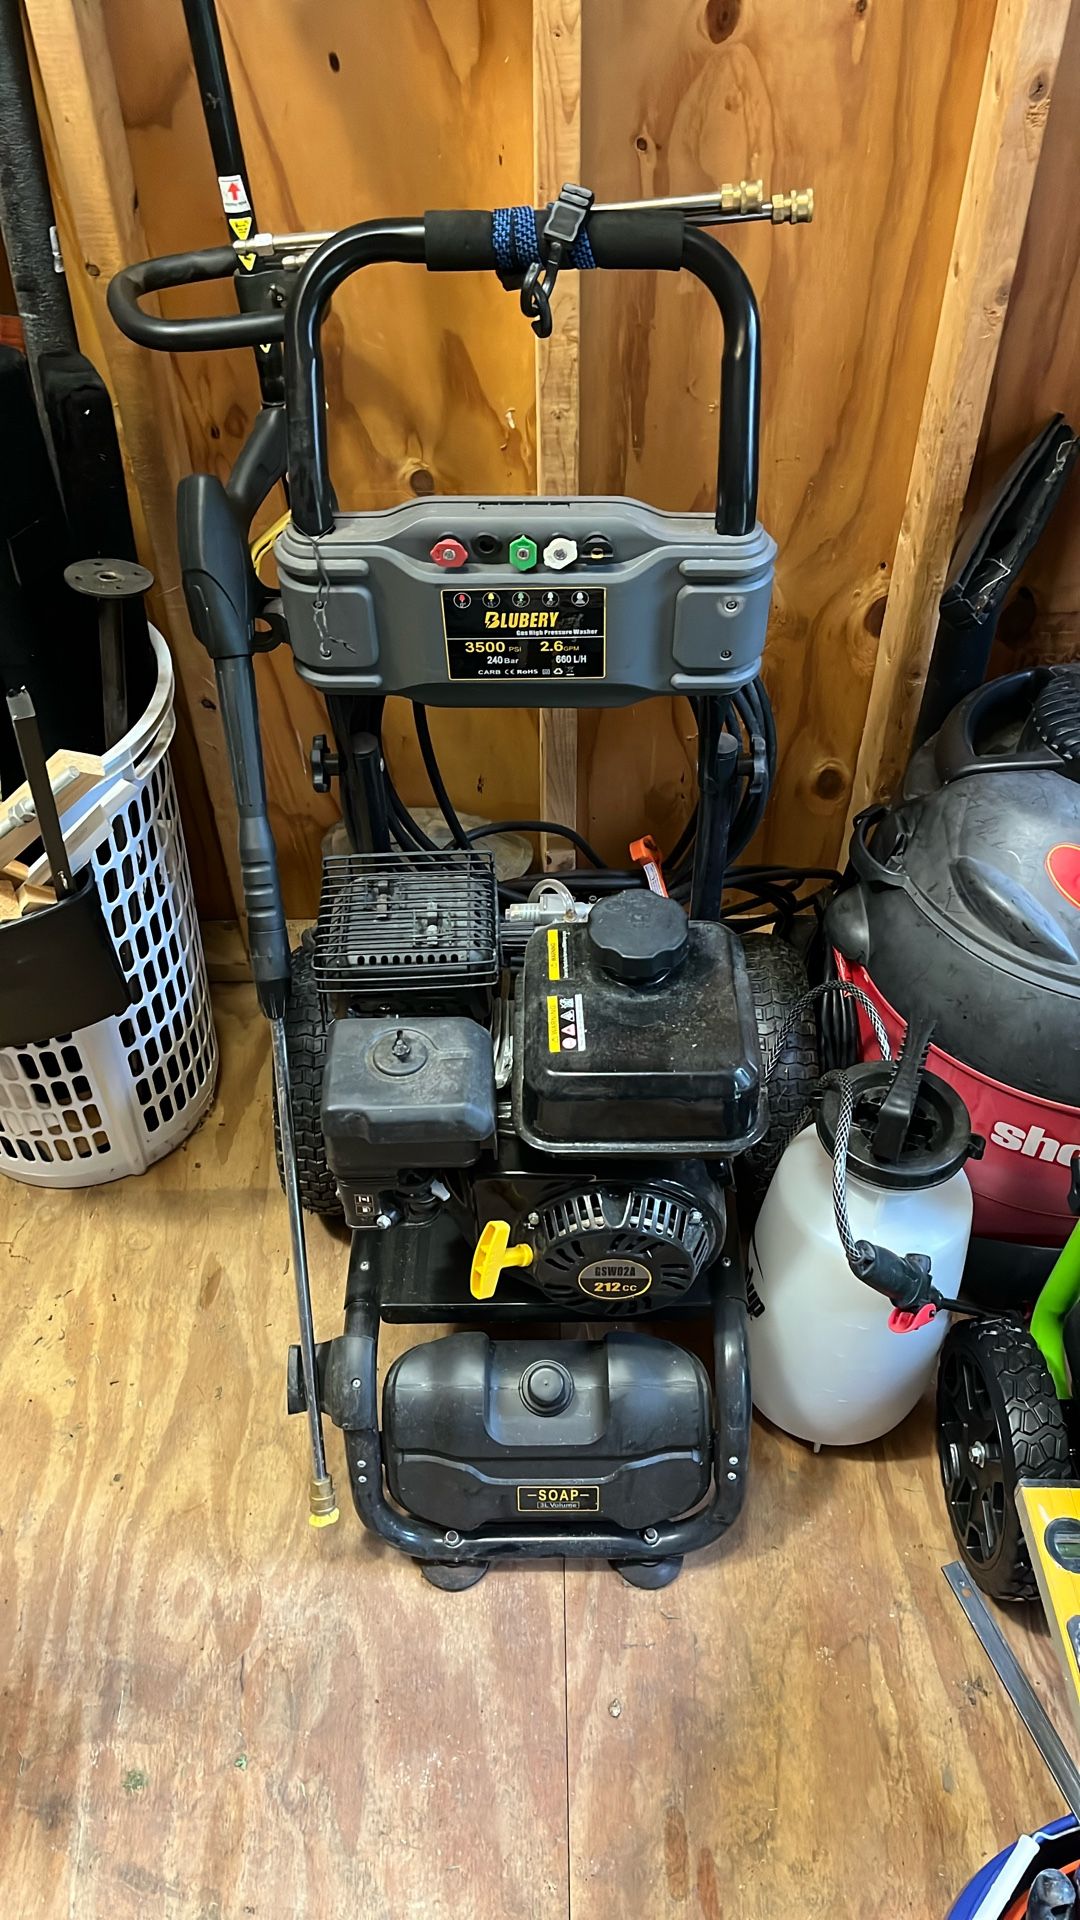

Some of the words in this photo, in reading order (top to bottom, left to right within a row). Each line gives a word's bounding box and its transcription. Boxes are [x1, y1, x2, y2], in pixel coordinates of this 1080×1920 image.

[484, 611, 560, 629] BLUBERY
[465, 641, 505, 653] 3500
[540, 641, 563, 652] 2.6
[487, 656, 503, 664] 240
[555, 655, 571, 664] 660
[573, 655, 587, 663] L/H
[593, 1282, 621, 1292] 212
